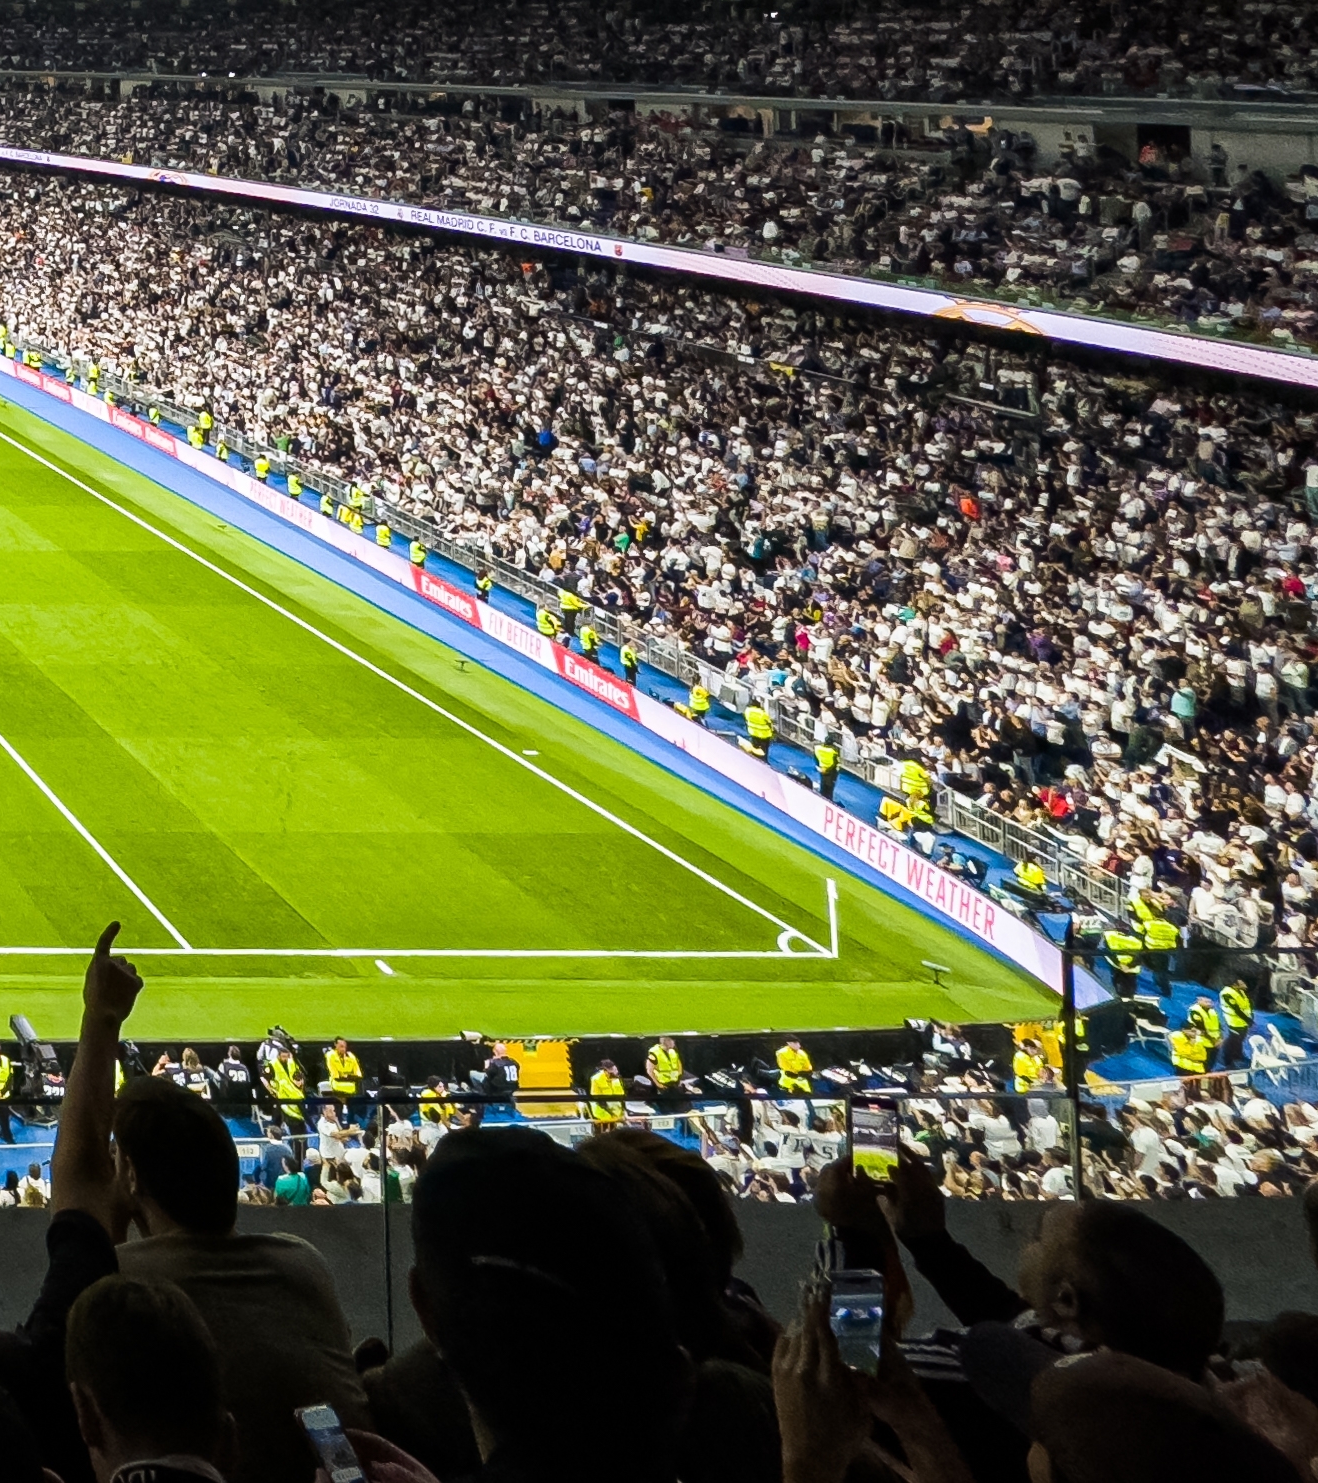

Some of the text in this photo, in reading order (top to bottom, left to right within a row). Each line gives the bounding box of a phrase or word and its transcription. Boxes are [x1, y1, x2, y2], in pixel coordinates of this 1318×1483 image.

[329, 197, 367, 213] JORNADA
[369, 204, 379, 215] 32
[411, 210, 434, 225] REAL
[437, 213, 474, 231] MADRID
[534, 230, 602, 252] BARCELONA
[421, 574, 473, 618] Emirates
[488, 612, 542, 659] FLY BETTER
[564, 654, 630, 709] Emirates
[823, 805, 995, 941] PERFECT WEATHER
